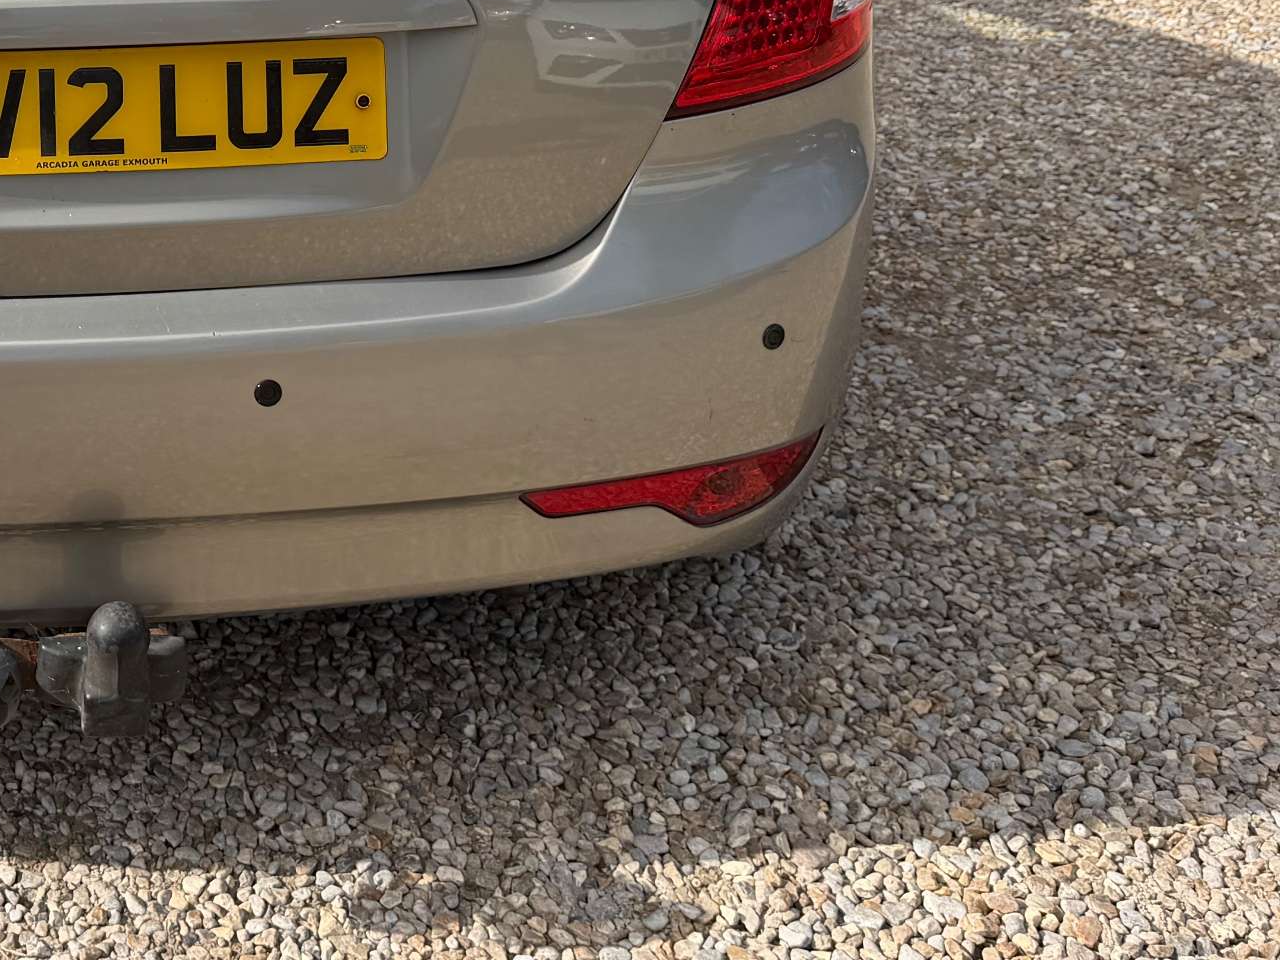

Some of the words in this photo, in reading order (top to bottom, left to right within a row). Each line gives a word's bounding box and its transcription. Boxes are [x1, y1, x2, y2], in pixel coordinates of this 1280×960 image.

[159, 56, 350, 152] LUZ
[36, 160, 79, 169] ARCADIA
[81, 159, 120, 168] GARAGE
[123, 157, 168, 166] EXMOUTH
